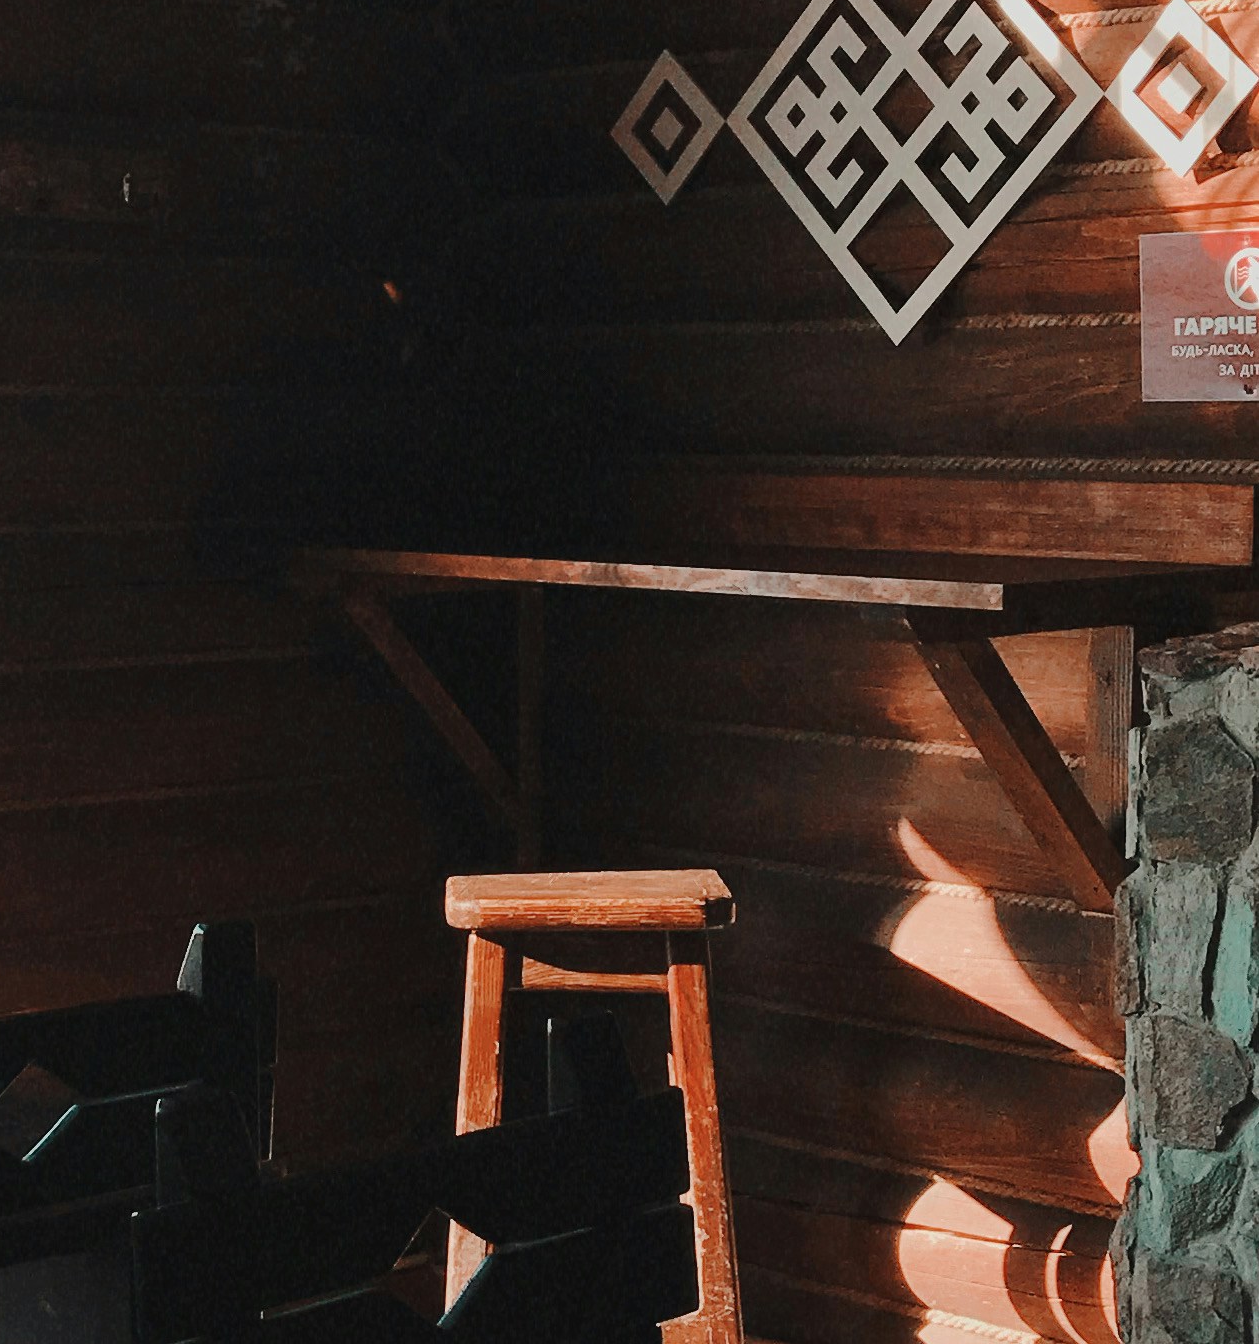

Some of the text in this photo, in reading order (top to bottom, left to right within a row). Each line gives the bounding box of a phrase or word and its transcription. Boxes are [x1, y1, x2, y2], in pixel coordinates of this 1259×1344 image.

[1174, 315, 1257, 336] ГАРЯЧЕ
[1171, 344, 1254, 358] БУДЬ-ЛАСКА,
[1218, 364, 1236, 376] ЗА
